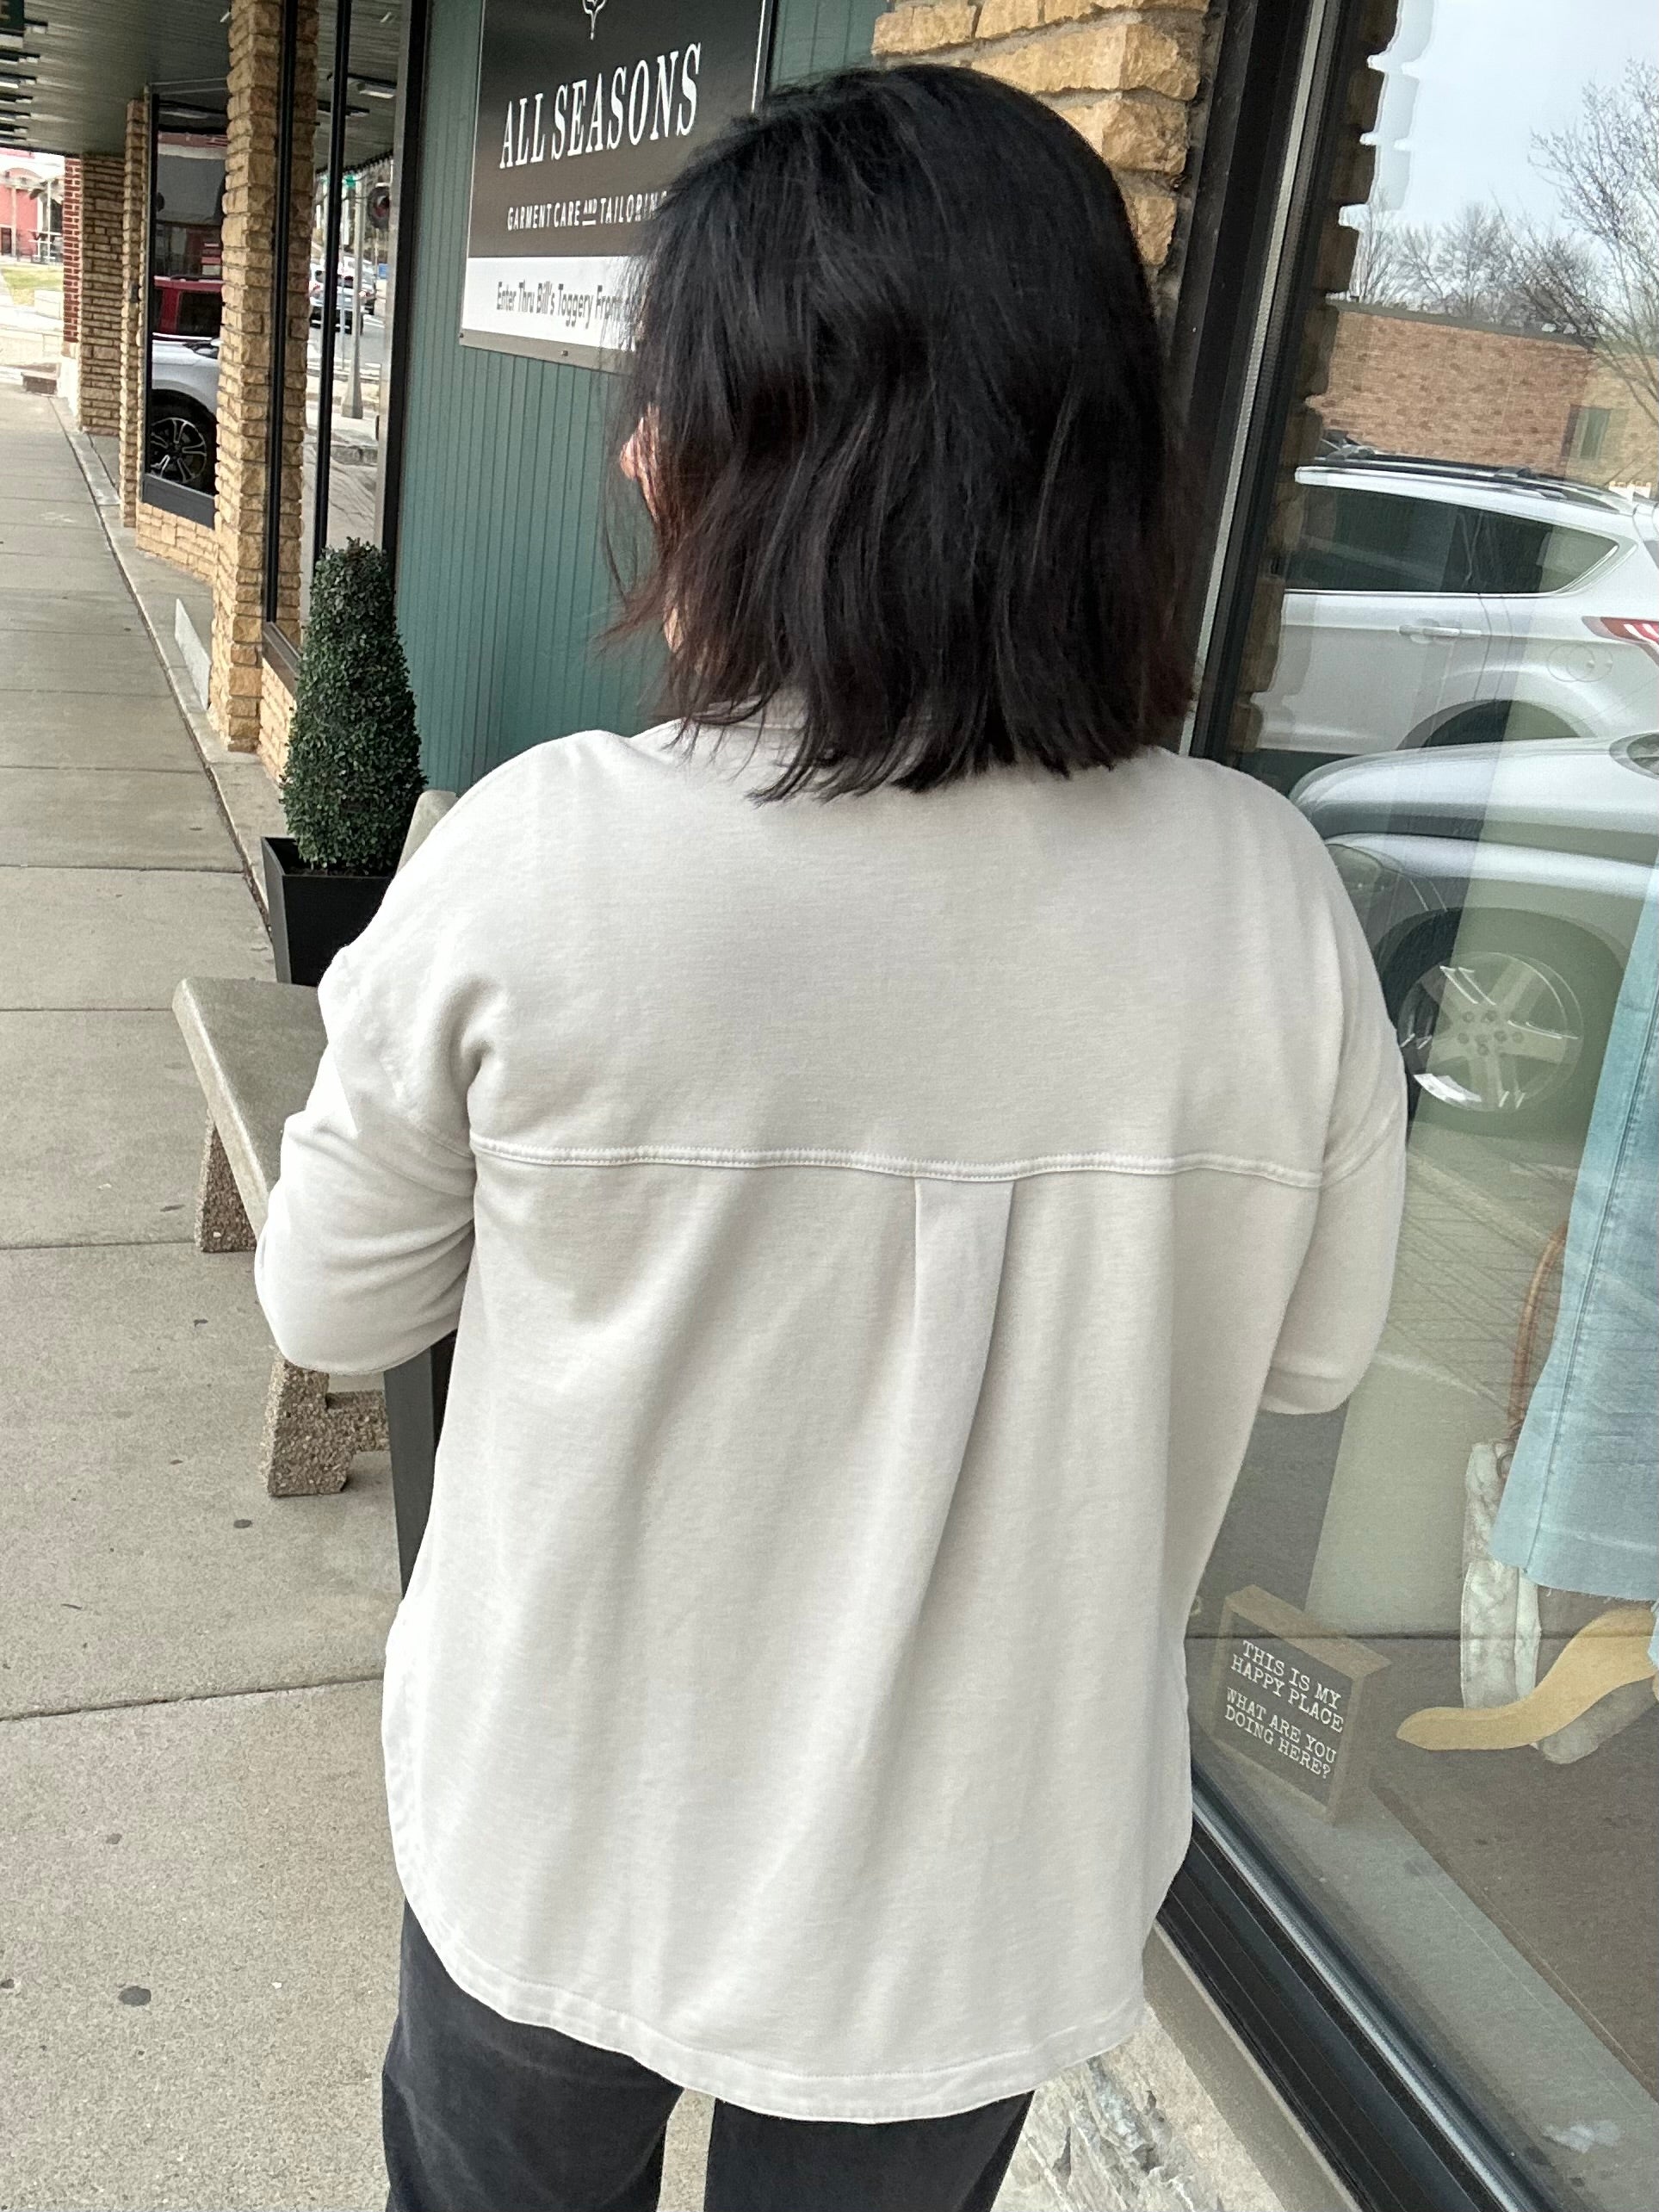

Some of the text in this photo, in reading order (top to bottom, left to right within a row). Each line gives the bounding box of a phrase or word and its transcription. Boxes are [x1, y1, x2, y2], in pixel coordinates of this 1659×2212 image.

[499, 42, 701, 169] ALL SEASONS
[507, 190, 667, 231] GARMENT CARE AND TAILORIN
[497, 281, 517, 311] Enter
[518, 280, 535, 313] Thru
[536, 281, 555, 316] Bill's
[558, 283, 594, 330] Toggery
[1230, 1654, 1344, 1734] HAPPY PLACE
[1242, 1639, 1342, 1711] THIS IS MY
[1224, 1705, 1331, 1780] DOING HERE?
[1227, 1687, 1336, 1763] WHAT ARE YOU
